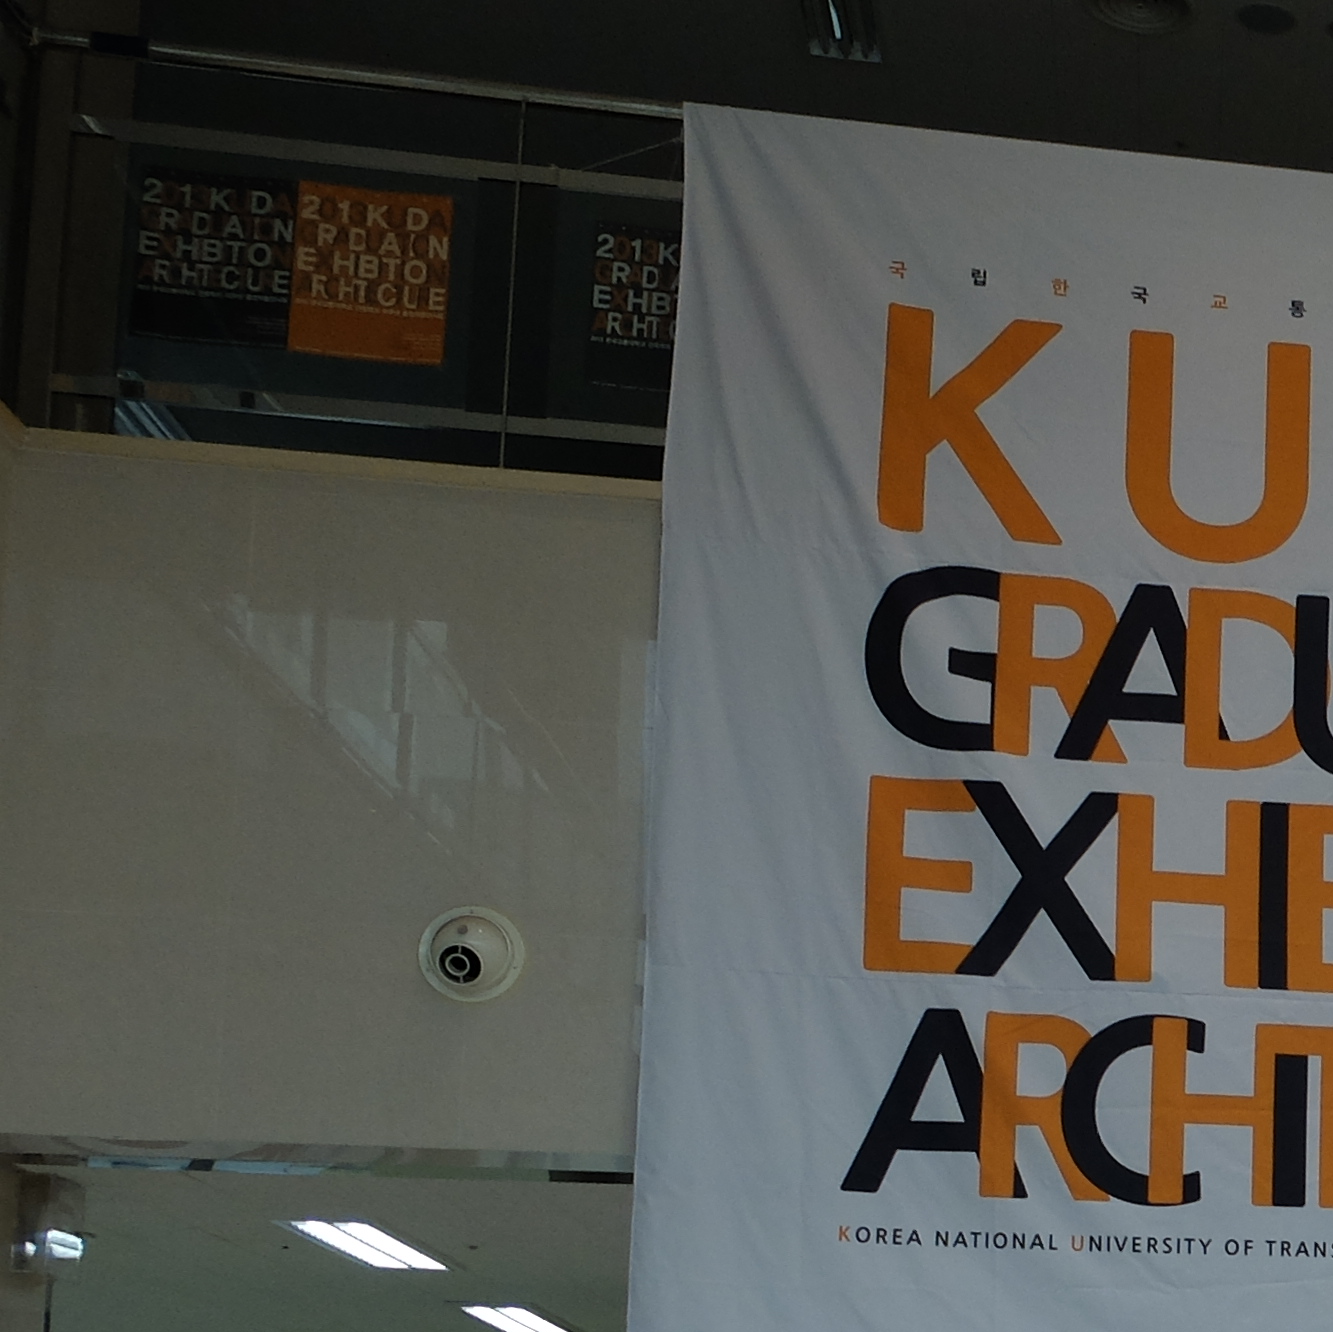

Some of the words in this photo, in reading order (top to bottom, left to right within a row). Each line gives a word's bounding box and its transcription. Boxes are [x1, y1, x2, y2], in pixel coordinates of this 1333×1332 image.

[838, 1225, 923, 1247] KOREA
[935, 1230, 1058, 1252] NATIONAL
[1071, 1235, 1213, 1257] UNIVERSITY
[1225, 1239, 1254, 1257] OF
